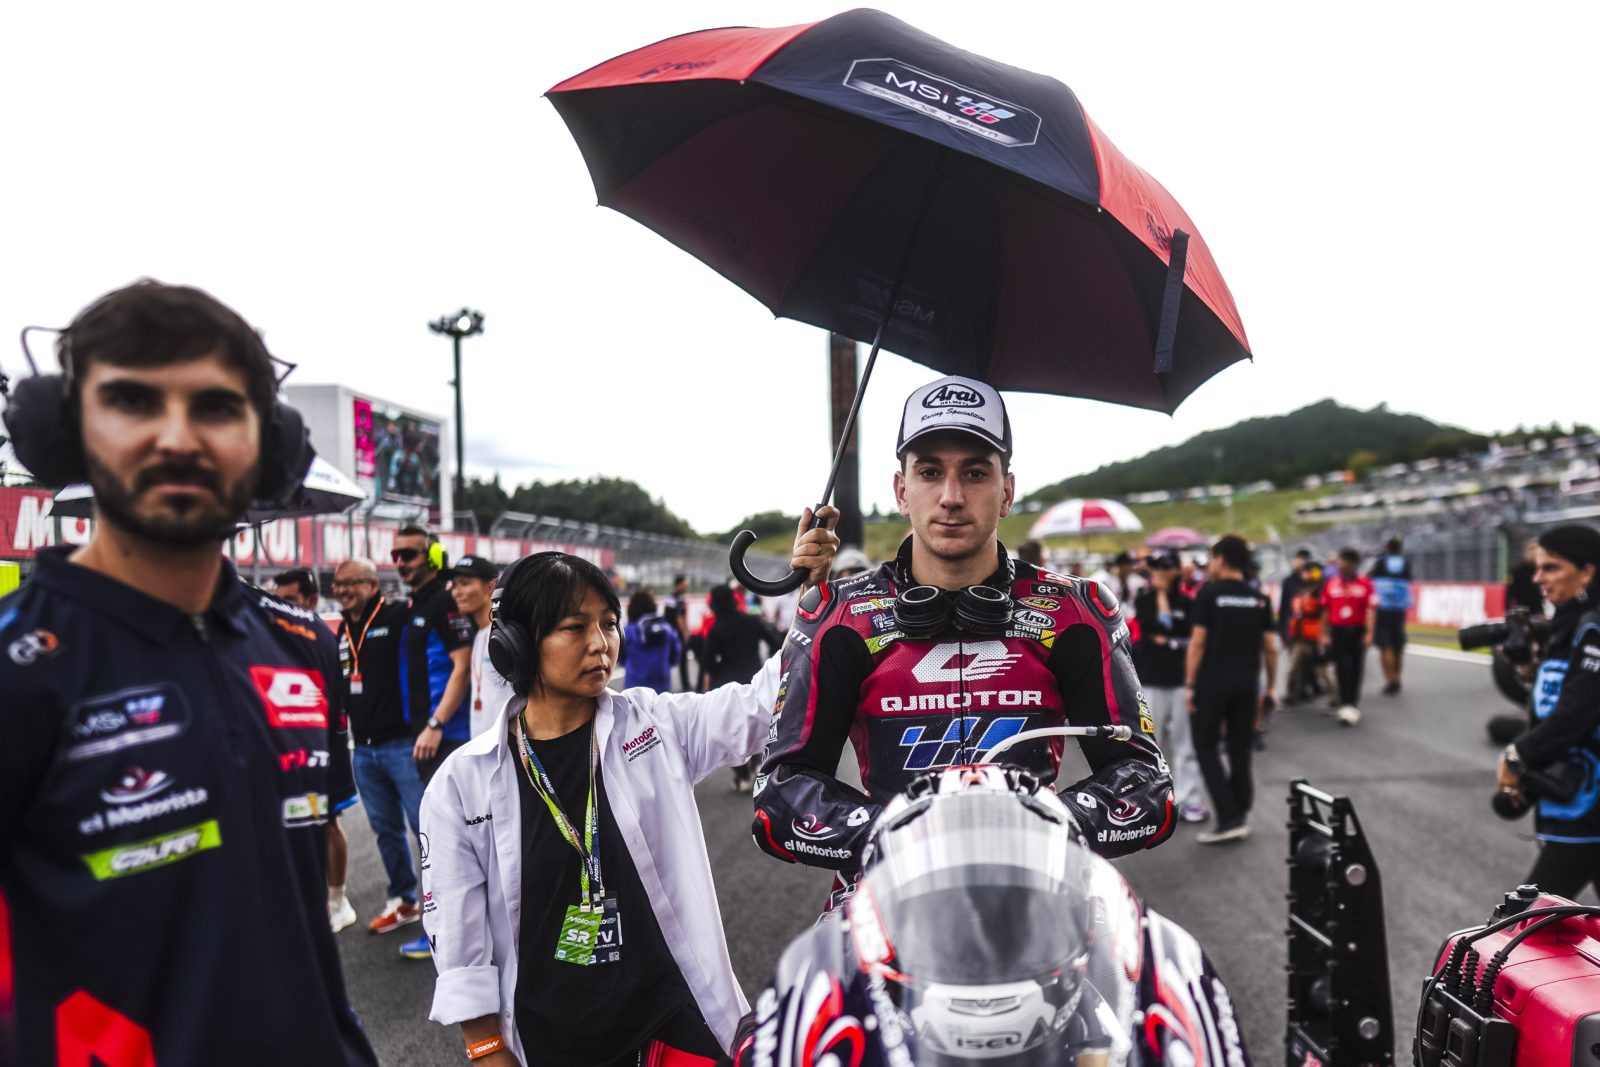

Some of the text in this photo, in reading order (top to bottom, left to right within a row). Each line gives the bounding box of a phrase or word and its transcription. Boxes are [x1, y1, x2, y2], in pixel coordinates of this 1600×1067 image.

[927, 385, 978, 406] Arai
[921, 411, 944, 422] Racing
[880, 690, 1043, 712] QJMOTOR
[622, 727, 654, 754] MotoGP
[1097, 824, 1157, 842] el Motorista
[784, 840, 853, 859] el Motorista
[566, 928, 591, 944] SR
